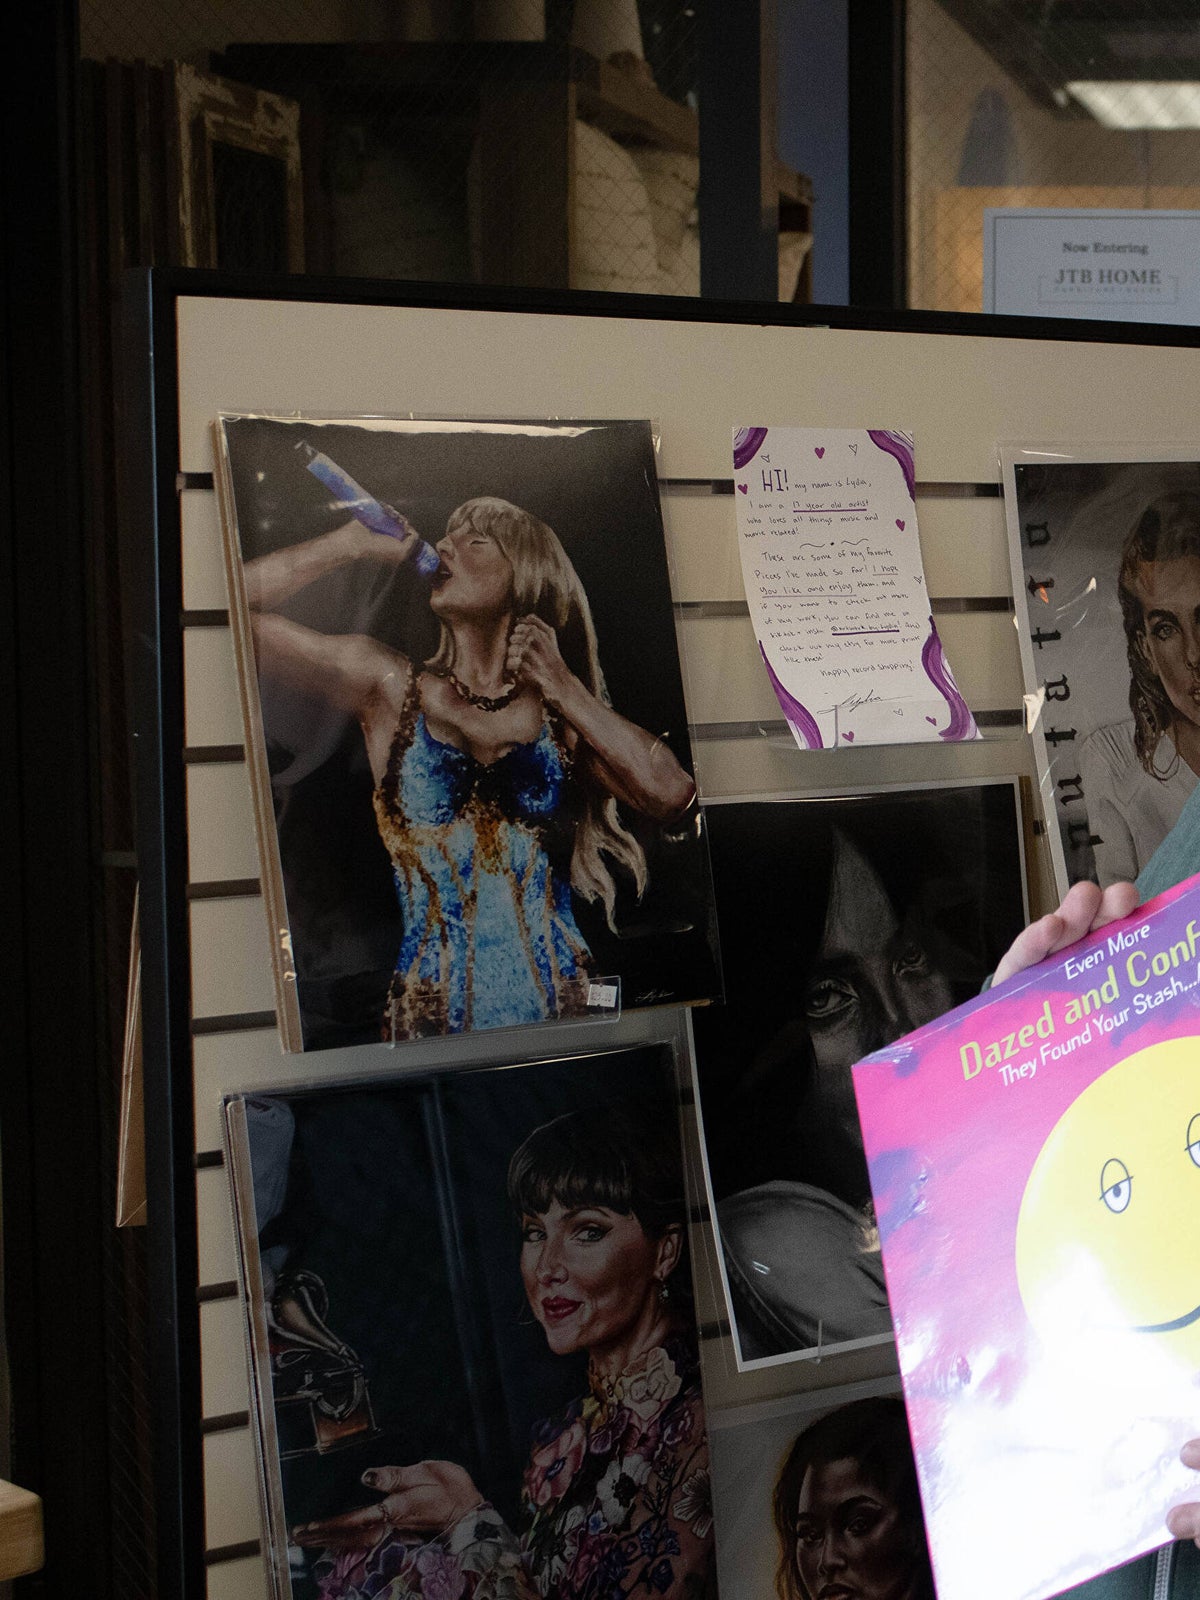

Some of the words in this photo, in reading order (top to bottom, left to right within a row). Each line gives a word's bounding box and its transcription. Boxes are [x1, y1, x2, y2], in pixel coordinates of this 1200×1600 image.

[1062, 241, 1088, 252] Now
[1093, 241, 1149, 256] Entering
[1055, 268, 1093, 284] JTB
[1099, 268, 1162, 284] HOME
[762, 469, 790, 492] HI!
[794, 482, 807, 492] my
[811, 481, 832, 489] name
[834, 480, 843, 488] is
[806, 502, 825, 510] year
[830, 500, 842, 508] old
[848, 500, 870, 508] artist
[768, 516, 787, 524] loves
[792, 516, 804, 524] all
[808, 516, 834, 526] things
[864, 512, 879, 522] and
[744, 530, 766, 539] movie
[770, 527, 800, 536] related!
[762, 551, 786, 562] These
[810, 554, 832, 562] some
[838, 550, 846, 558] of
[850, 552, 866, 562] my
[866, 546, 894, 557] favorite
[805, 568, 828, 578] made
[880, 564, 899, 574] hope
[783, 586, 802, 594] like
[807, 584, 825, 592] and
[828, 582, 853, 593] enjoy
[846, 598, 872, 606] check
[852, 664, 876, 673] record
[1063, 949, 1104, 980] Even
[1107, 924, 1150, 956] More
[959, 1000, 1056, 1080] Dazed
[1064, 965, 1120, 1026] and
[998, 1060, 1038, 1086] They
[1040, 1026, 1092, 1066] Found
[1092, 1008, 1131, 1041] Your
